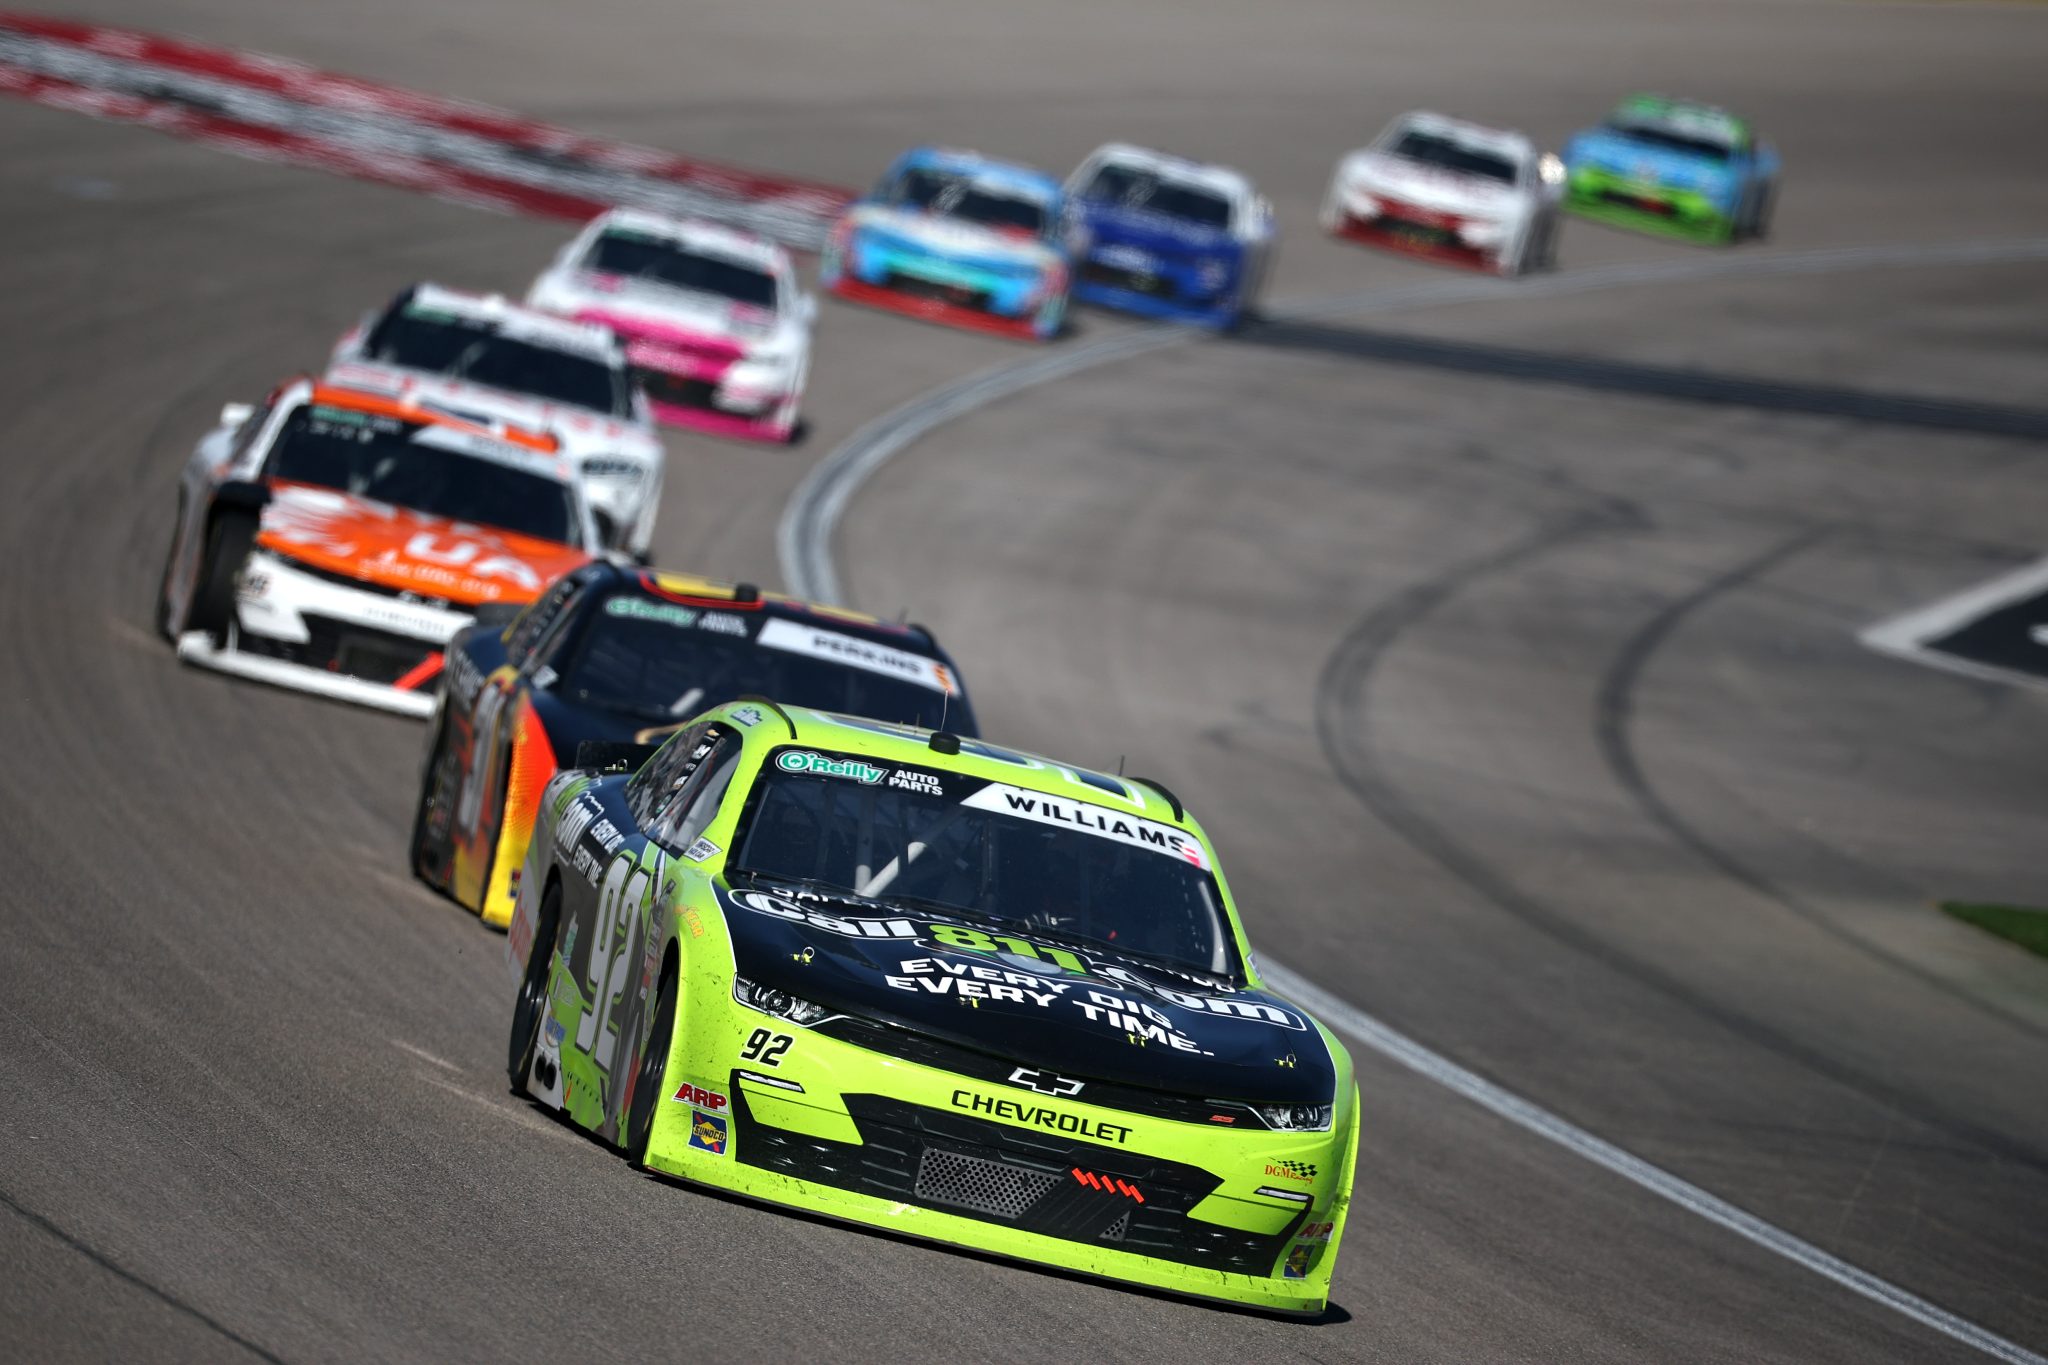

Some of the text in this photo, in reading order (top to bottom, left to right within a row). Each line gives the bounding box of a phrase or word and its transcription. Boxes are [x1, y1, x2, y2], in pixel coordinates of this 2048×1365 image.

[782, 751, 880, 782] O'Reilly
[895, 769, 939, 786] AUTO
[889, 776, 943, 796] PARTS
[1005, 793, 1186, 853] WILLIAMS
[575, 853, 650, 1075] 92
[900, 957, 1071, 994] EVERY
[885, 974, 1215, 1057] EVERY TIME.
[739, 1028, 793, 1067] 92
[674, 1082, 727, 1111] ARP
[694, 1125, 725, 1141] SUNOCO
[951, 1089, 1133, 1144] CHEVROLET
